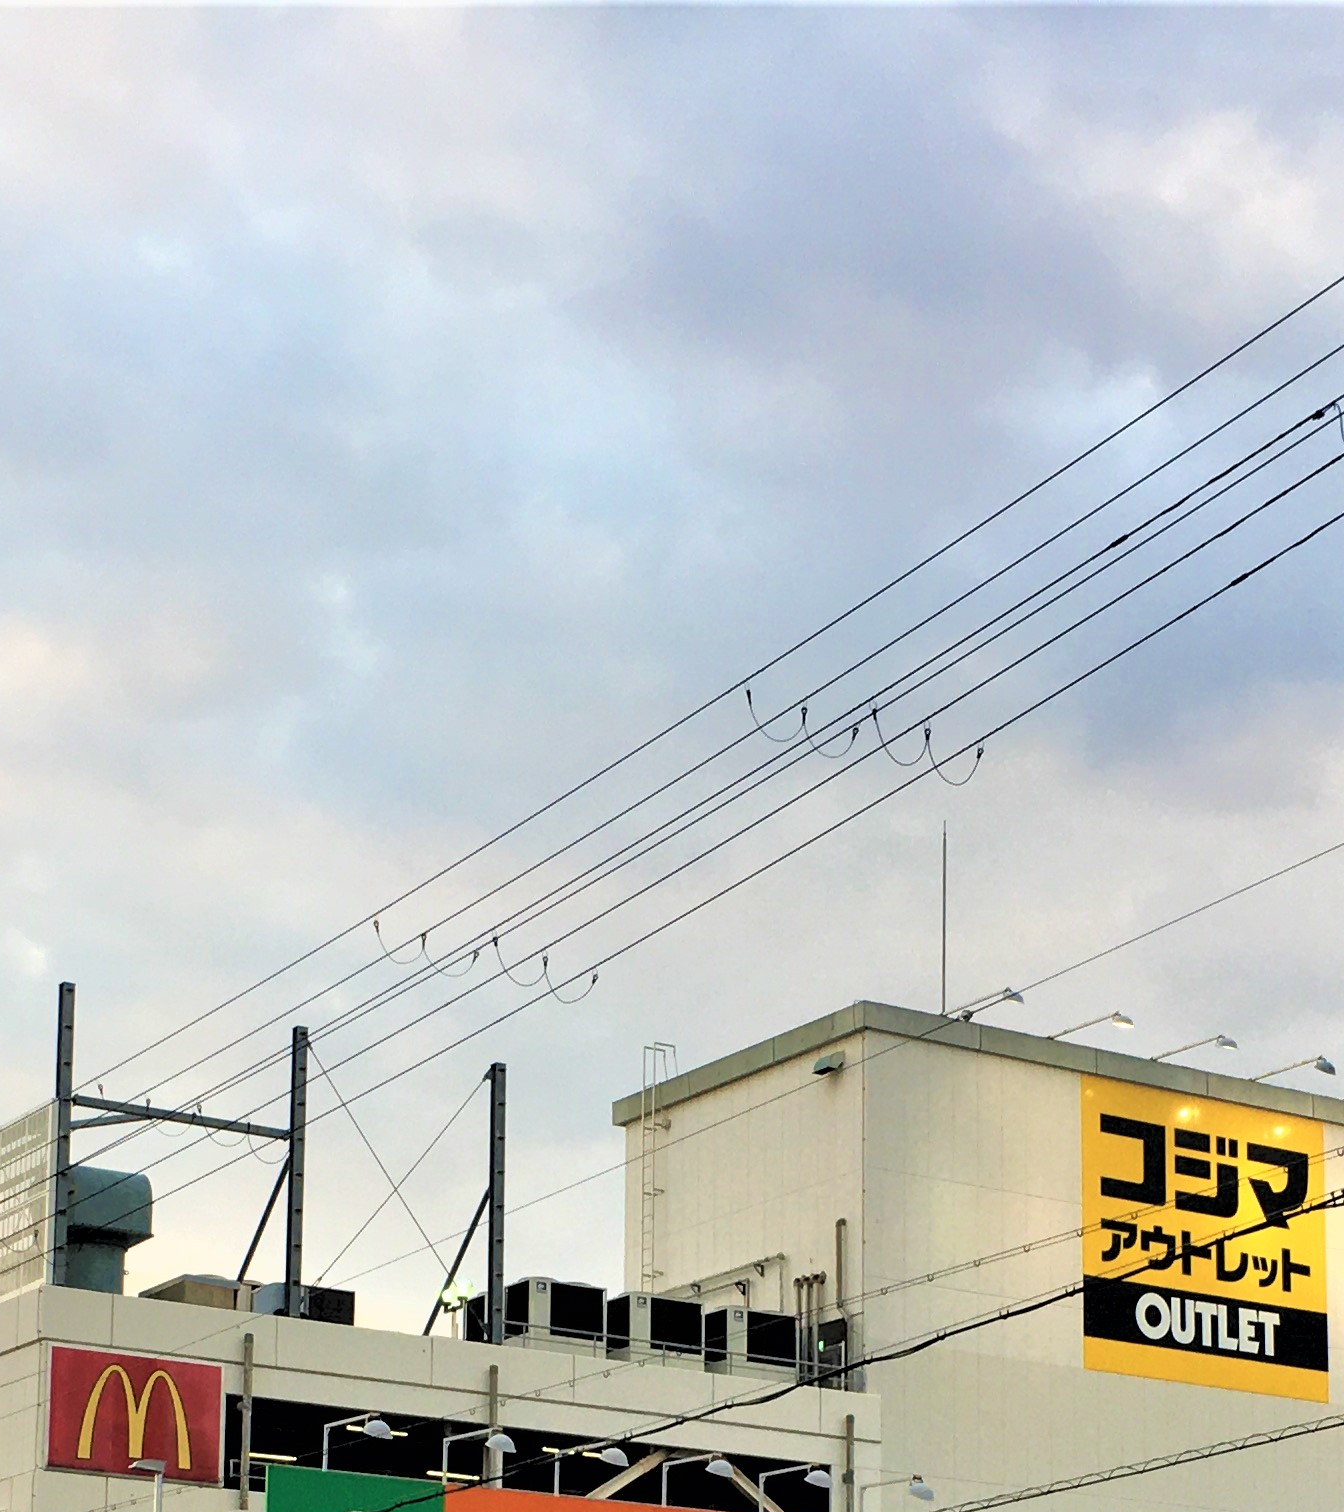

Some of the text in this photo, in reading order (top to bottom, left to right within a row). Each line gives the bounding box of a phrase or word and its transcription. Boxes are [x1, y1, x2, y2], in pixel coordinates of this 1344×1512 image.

[1099, 1112, 1309, 1230] コジマ
[1100, 1217, 1311, 1292] アウトレット
[1135, 1291, 1281, 1357] OUTLET
